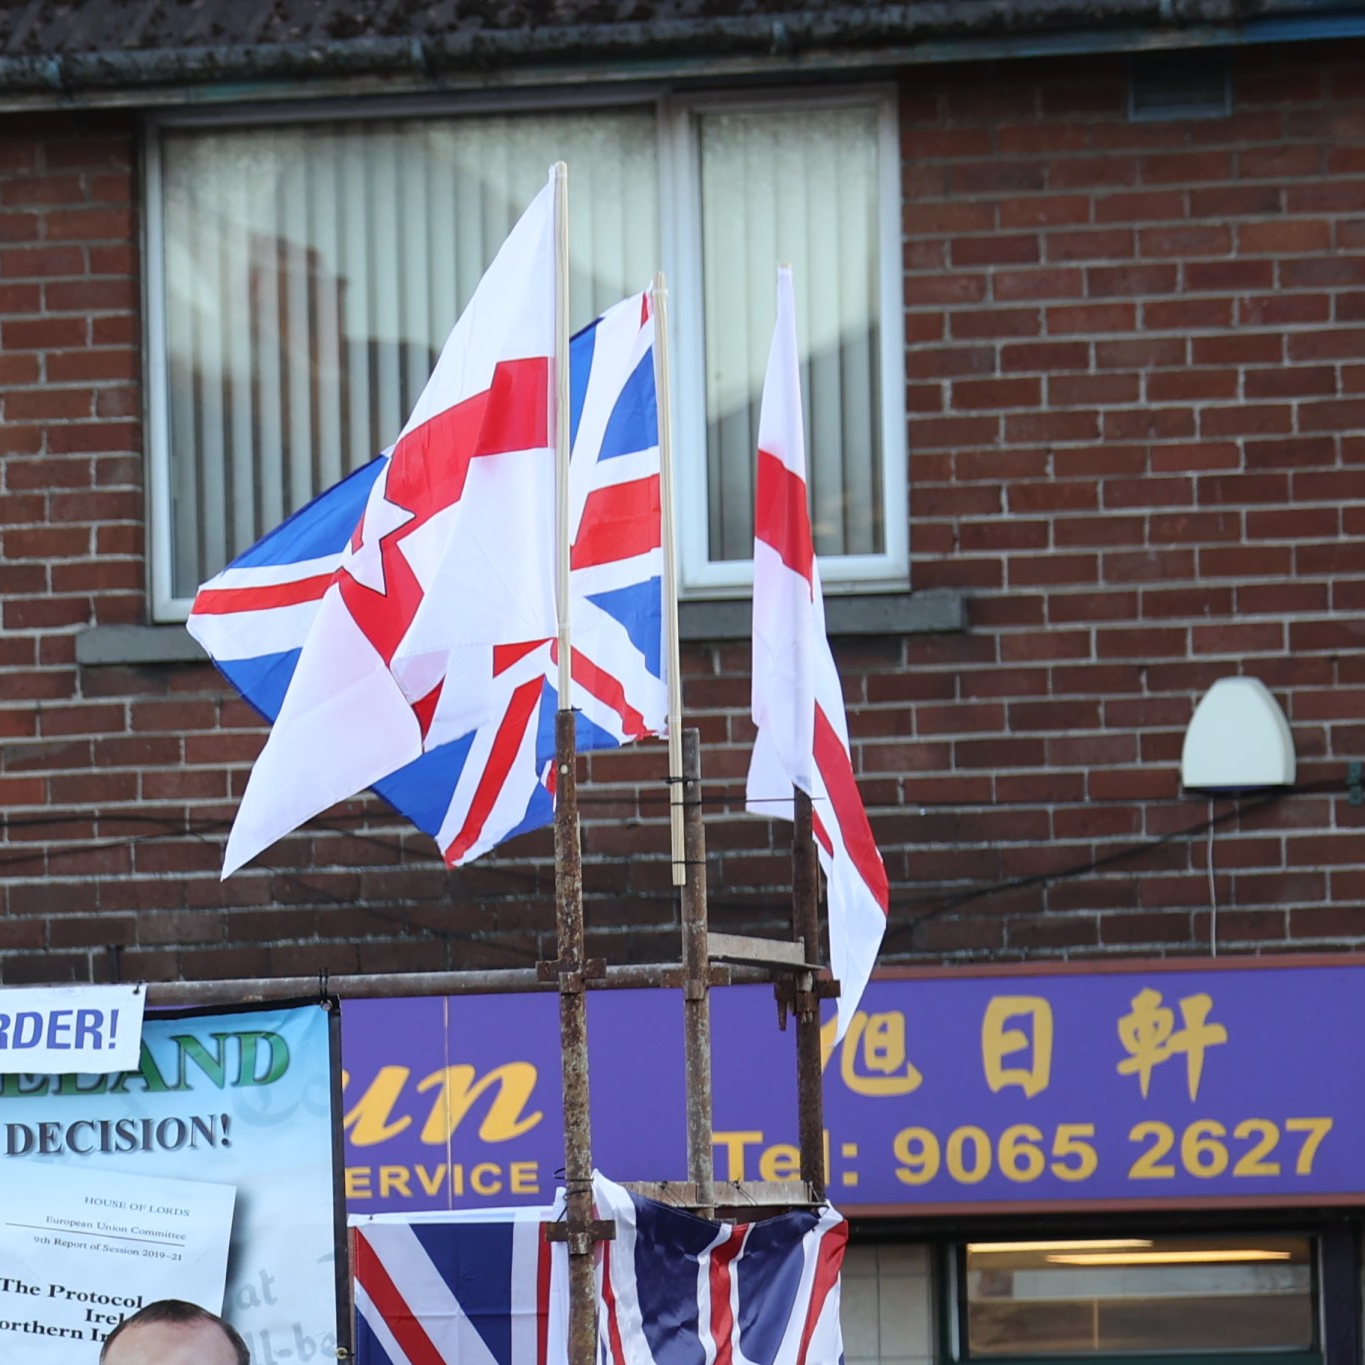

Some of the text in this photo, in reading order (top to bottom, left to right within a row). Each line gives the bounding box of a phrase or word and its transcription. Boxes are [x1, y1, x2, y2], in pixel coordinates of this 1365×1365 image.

[821, 986, 1228, 1103] 旭日軒
[4, 1113, 233, 1158] DECISION!
[893, 1123, 1098, 1185] 9065
[1127, 1116, 1334, 1181] 2627
[84, 1196, 190, 1217] HOUSE OF LORDS
[46, 1215, 187, 1241] European Union Committee
[33, 1236, 51, 1246] 9th
[54, 1238, 87, 1251] Report
[90, 1243, 101, 1251] of
[103, 1244, 139, 1257] Session
[48, 1284, 143, 1310] Protocol
